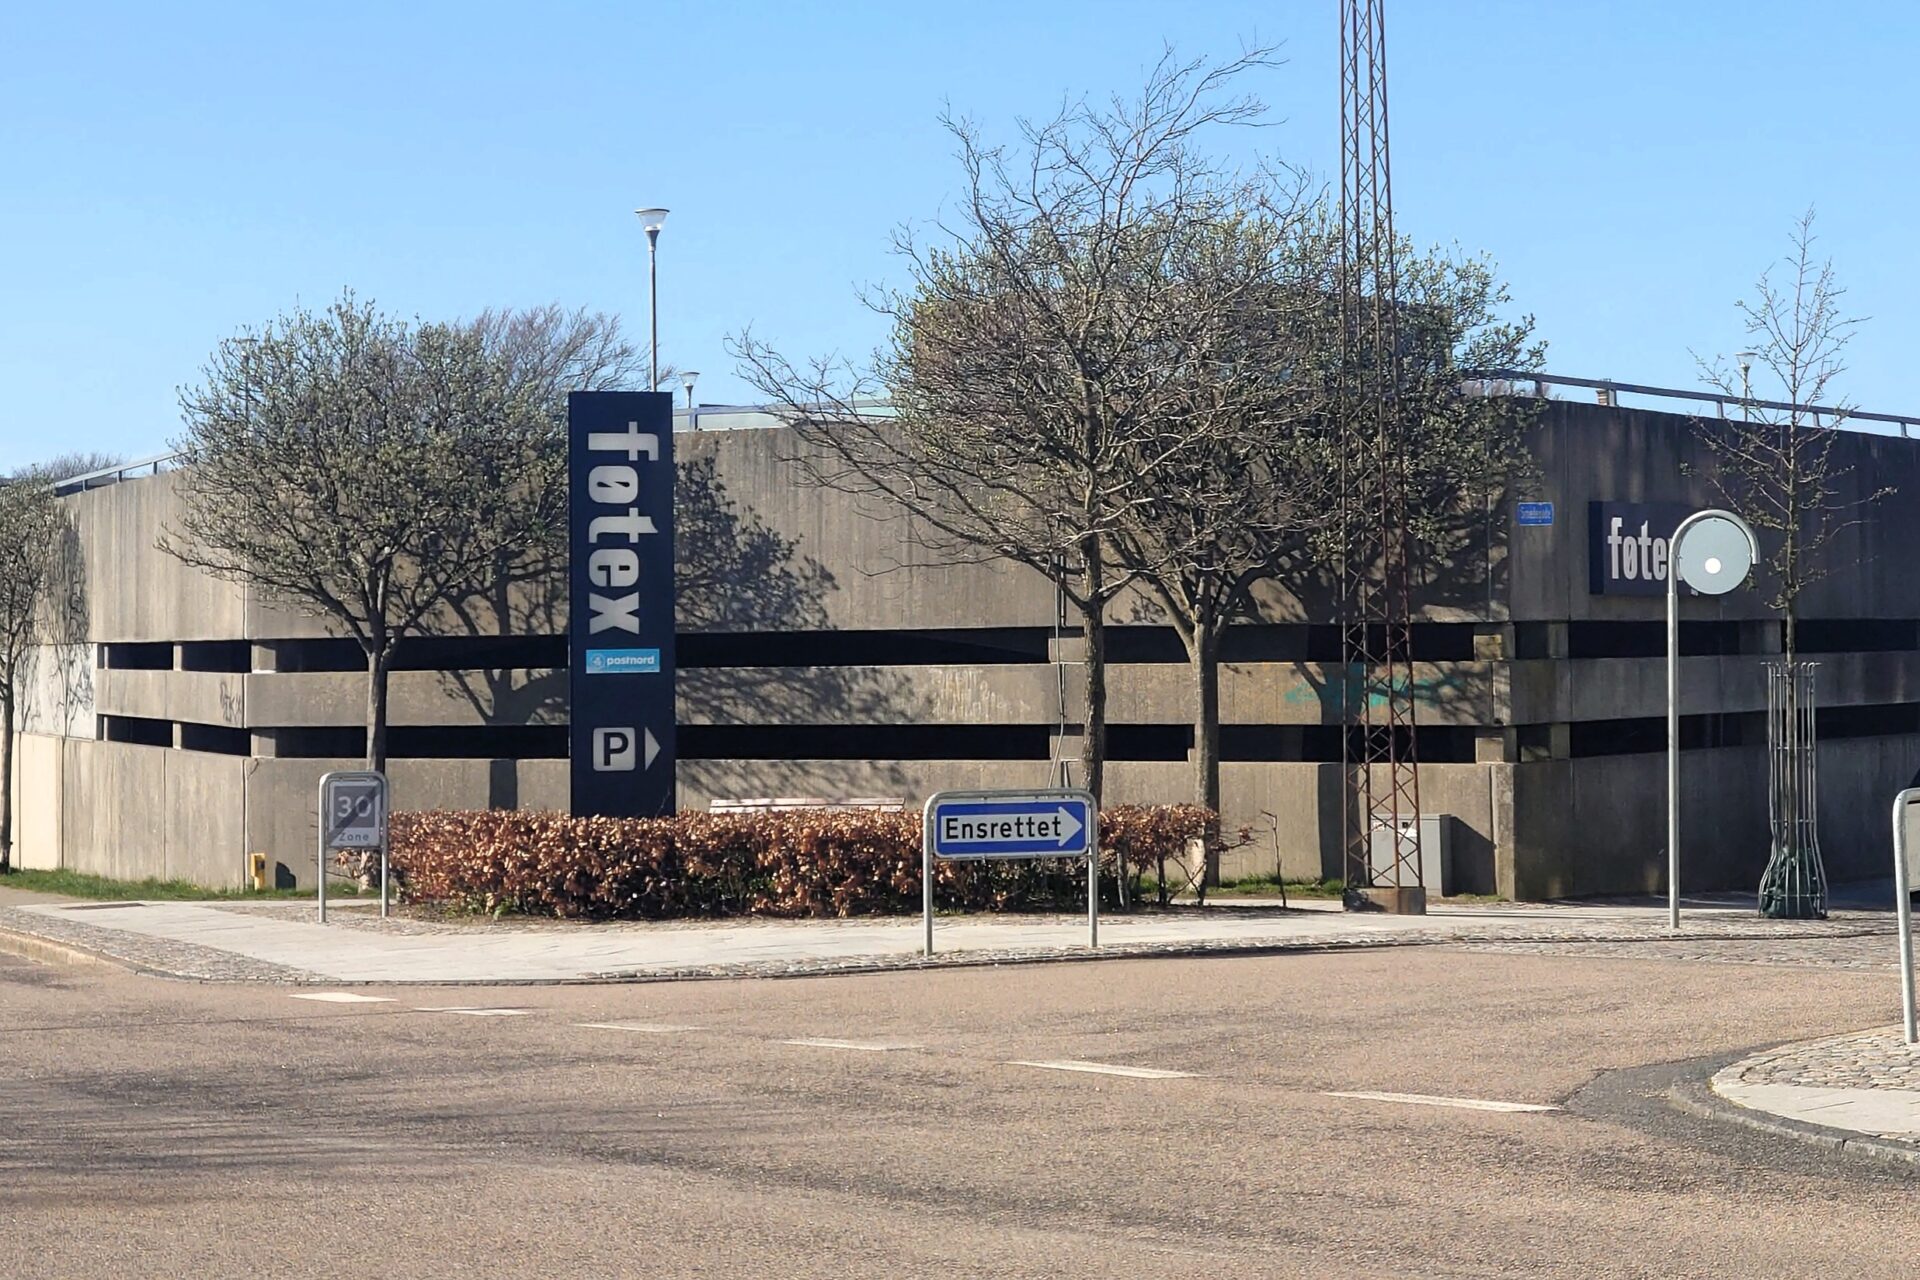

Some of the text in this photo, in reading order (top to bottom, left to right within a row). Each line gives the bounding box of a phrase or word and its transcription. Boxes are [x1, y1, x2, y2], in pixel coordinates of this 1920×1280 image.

[588, 421, 659, 635] føtex
[1607, 517, 1683, 581] føte
[606, 655, 655, 666] postnord
[603, 732, 629, 767] P
[337, 795, 372, 818] 30
[339, 832, 369, 841] Zone
[945, 815, 1061, 840] Ensrettet
